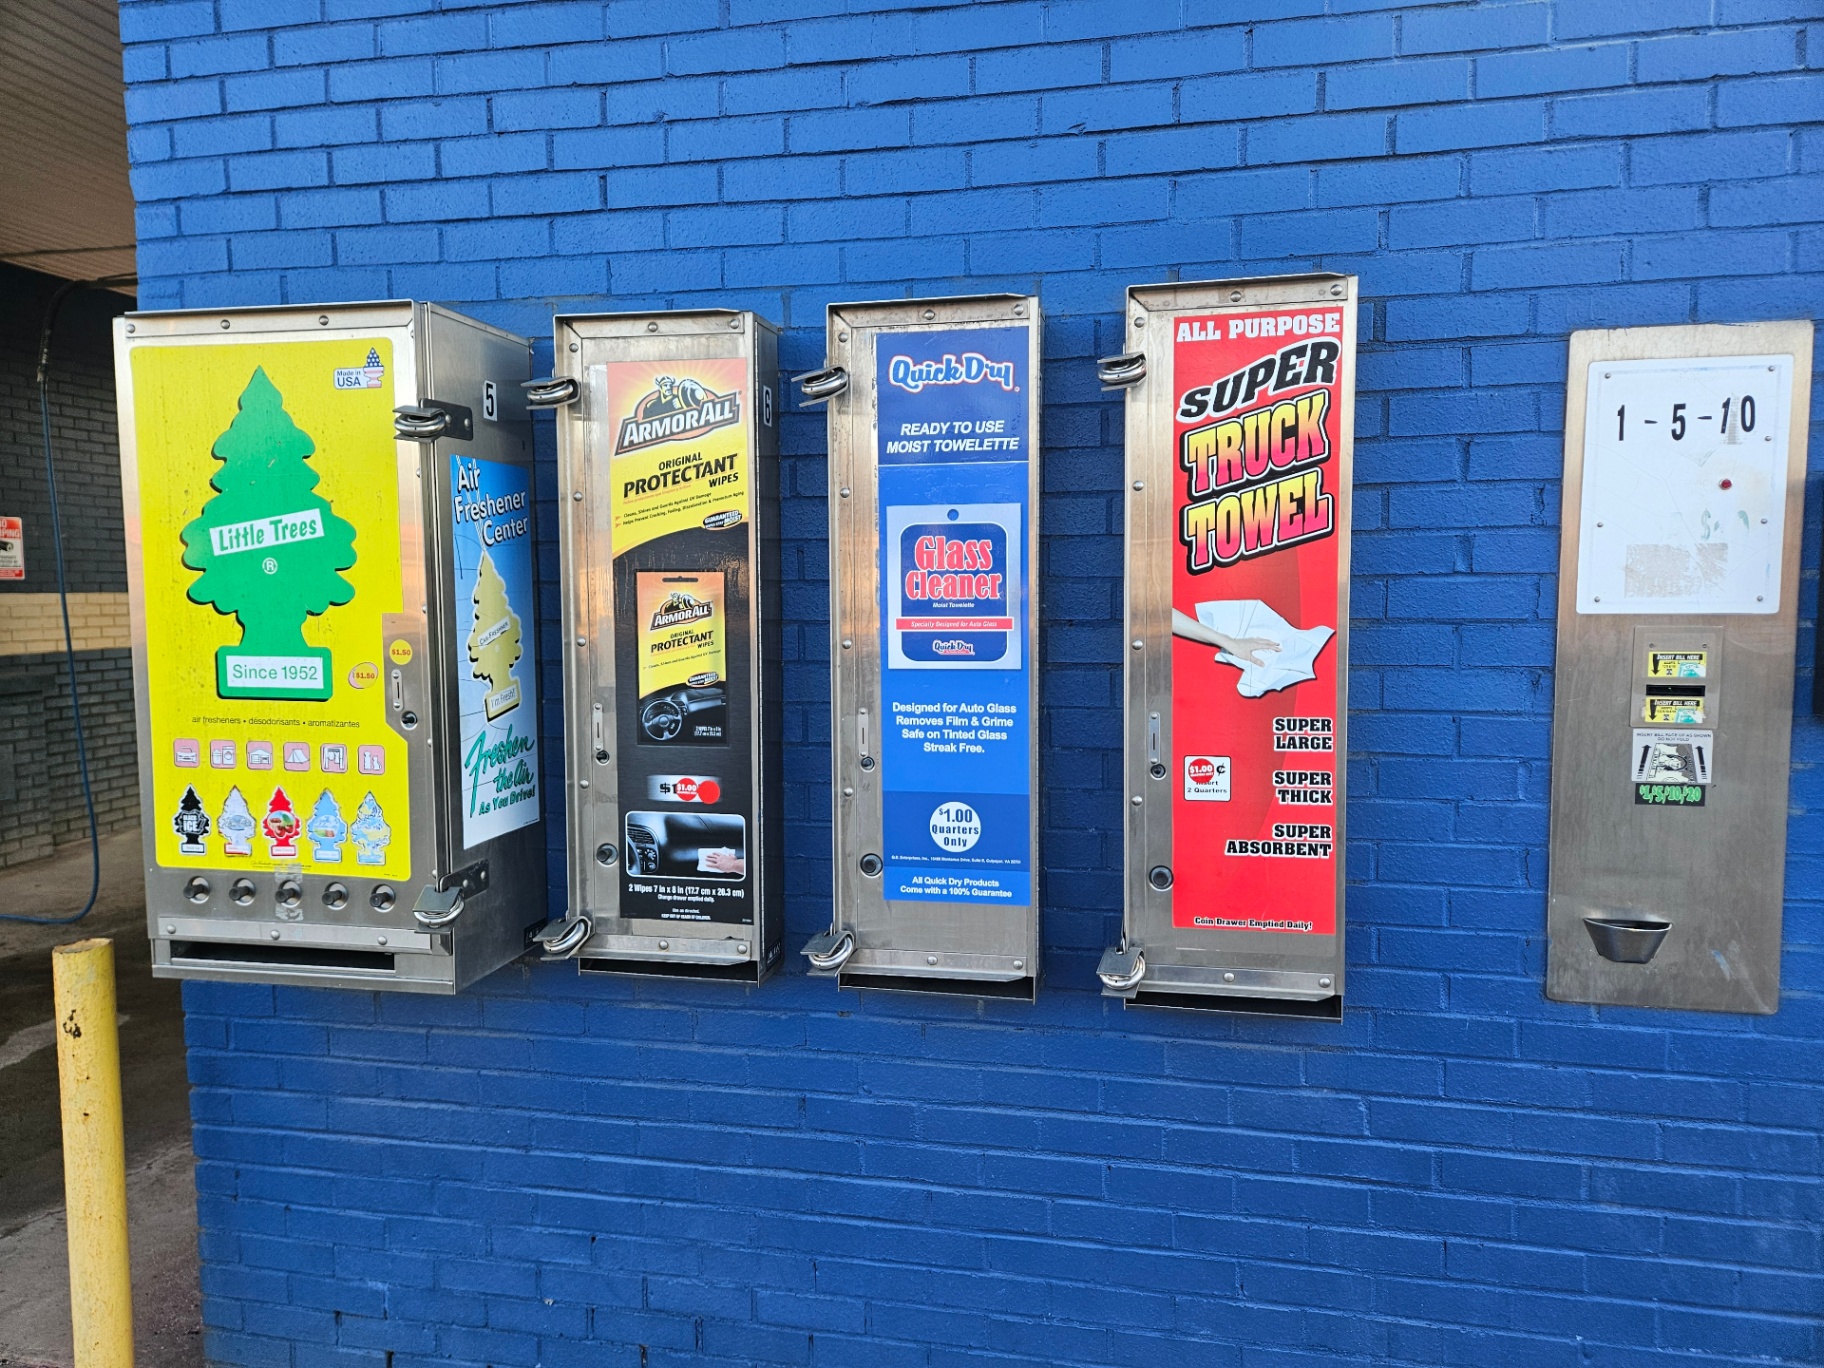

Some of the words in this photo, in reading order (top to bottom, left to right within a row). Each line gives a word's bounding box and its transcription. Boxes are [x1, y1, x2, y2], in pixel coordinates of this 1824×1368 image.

[1176, 320, 1221, 342] ALL
[1229, 313, 1340, 339] PURPOSE
[337, 377, 361, 387] USA
[1177, 337, 1341, 422] SUPER
[485, 383, 494, 417] 5
[765, 389, 771, 424] 6
[1617, 405, 1625, 441] 1
[1671, 403, 1686, 441] 5
[1720, 394, 1756, 434] 10
[901, 422, 950, 436] READY
[953, 421, 973, 434] TO
[975, 420, 1005, 433] USE
[886, 440, 931, 454] MOIST
[933, 437, 1019, 452] TOWELETTE
[1184, 389, 1328, 496] TRUCK
[658, 452, 703, 471] ORIGINAL
[457, 462, 481, 493] Air
[623, 453, 738, 498] PROTECTANT
[708, 472, 739, 488] WIPES
[454, 490, 526, 524] Freshener
[1184, 467, 1332, 570] TOWEL
[219, 523, 265, 552] Little
[269, 518, 317, 542] Trees
[482, 517, 528, 547] Center
[915, 536, 992, 571] Glass
[905, 571, 1002, 600] Cleaner
[651, 630, 714, 653] PROTECTANT
[670, 629, 694, 639] ORIGINAL
[697, 640, 714, 649] WIPES
[232, 664, 278, 680] Since
[281, 665, 318, 681] 1952
[892, 702, 940, 714] Designed
[942, 702, 958, 713] for
[959, 703, 985, 713] Auto
[986, 703, 1017, 714] Glass
[202, 716, 241, 724] fresheners
[308, 719, 360, 728] aromatizantes
[896, 715, 943, 726] Removes
[945, 716, 968, 726] Film
[971, 716, 979, 726] &
[981, 717, 1014, 727] Grime
[1273, 717, 1333, 733] SUPER
[902, 729, 924, 739] Safe
[926, 731, 940, 739] on
[942, 729, 976, 739] Tinted
[977, 730, 1007, 740] Glass
[924, 742, 957, 752] Streak
[959, 743, 985, 753] Free.
[1275, 735, 1333, 752] LARGE
[464, 723, 535, 819] Freshen
[492, 767, 514, 793] the
[514, 758, 534, 788] Air
[1190, 764, 1213, 774] $1.00
[1273, 771, 1332, 787] SUPER
[677, 783, 697, 792] $1.00
[479, 801, 491, 816] As
[493, 795, 509, 810] You
[510, 784, 536, 805] Drive!
[1277, 789, 1332, 805] THICK
[939, 808, 973, 823] $1.00
[931, 824, 979, 836] Quarters
[1273, 824, 1332, 840] SUPER
[943, 836, 967, 847] Only
[1225, 840, 1332, 858] ABSORBENT
[912, 876, 923, 884] All
[924, 876, 947, 885] Quick
[948, 878, 962, 887] Dry
[964, 878, 1000, 887] Products
[628, 884, 633, 892] 2
[634, 884, 653, 894] Wipes
[659, 885, 666, 893] in
[672, 886, 677, 894] 8
[677, 886, 684, 895] in
[685, 886, 700, 896] (17.7
[700, 888, 711, 896] cm
[717, 888, 731, 897] 20.3
[732, 889, 744, 899] cm)
[900, 885, 923, 894] Come
[924, 886, 941, 894] with
[949, 887, 970, 896] 100%
[971, 888, 1013, 898] Guarantee
[1194, 917, 1214, 926] Coin
[1215, 918, 1246, 927] Drawer
[1248, 919, 1284, 930] Emptied
[1286, 920, 1313, 931] Daily!
